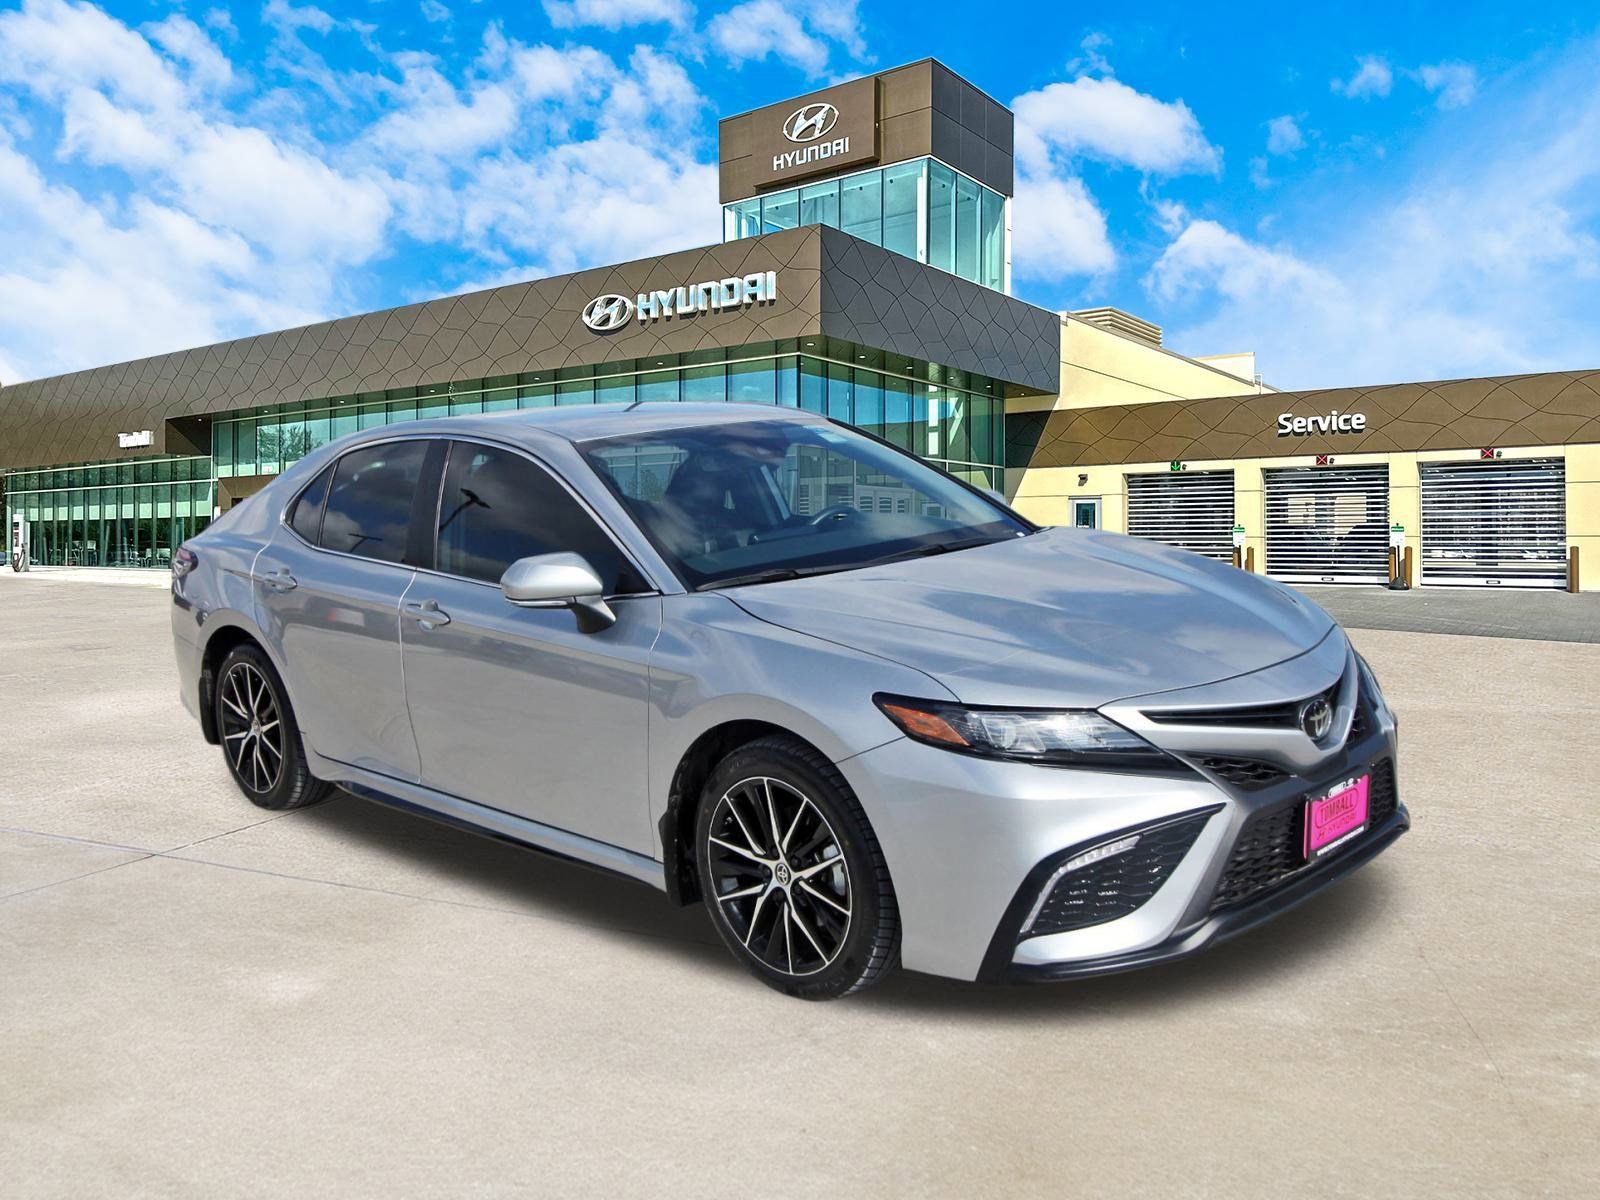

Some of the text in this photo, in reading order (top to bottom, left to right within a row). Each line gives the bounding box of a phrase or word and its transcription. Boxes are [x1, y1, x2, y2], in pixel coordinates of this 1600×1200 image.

[773, 137, 849, 171] HYUNDAI
[637, 270, 777, 321] HYUNDAI
[1278, 410, 1367, 434] Service
